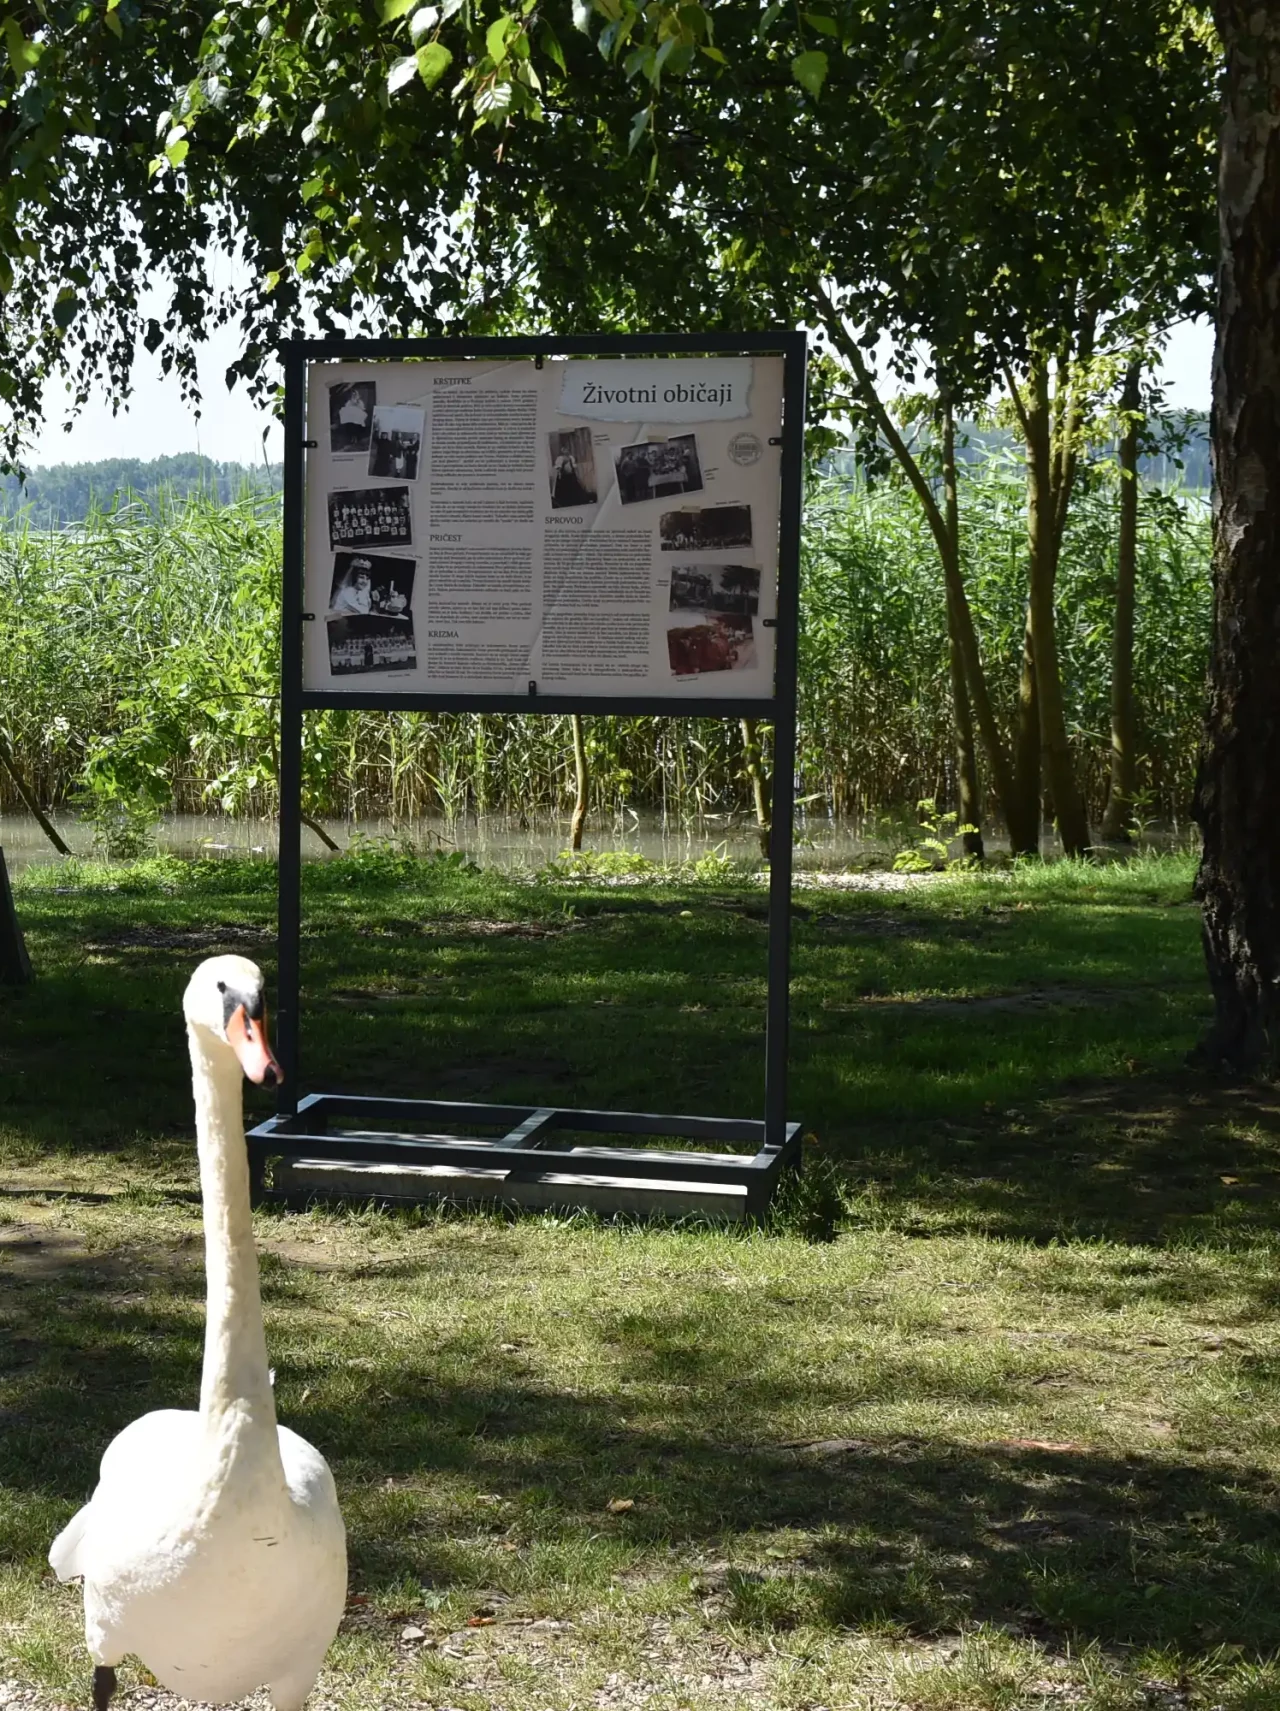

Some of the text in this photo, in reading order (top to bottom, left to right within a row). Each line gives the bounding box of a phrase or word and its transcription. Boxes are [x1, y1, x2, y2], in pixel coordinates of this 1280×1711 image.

[582, 381, 732, 407] Životni običaji
[544, 516, 584, 526] SPROVOD
[429, 533, 462, 543] PRIČEST
[428, 630, 459, 638] KRIZMA
